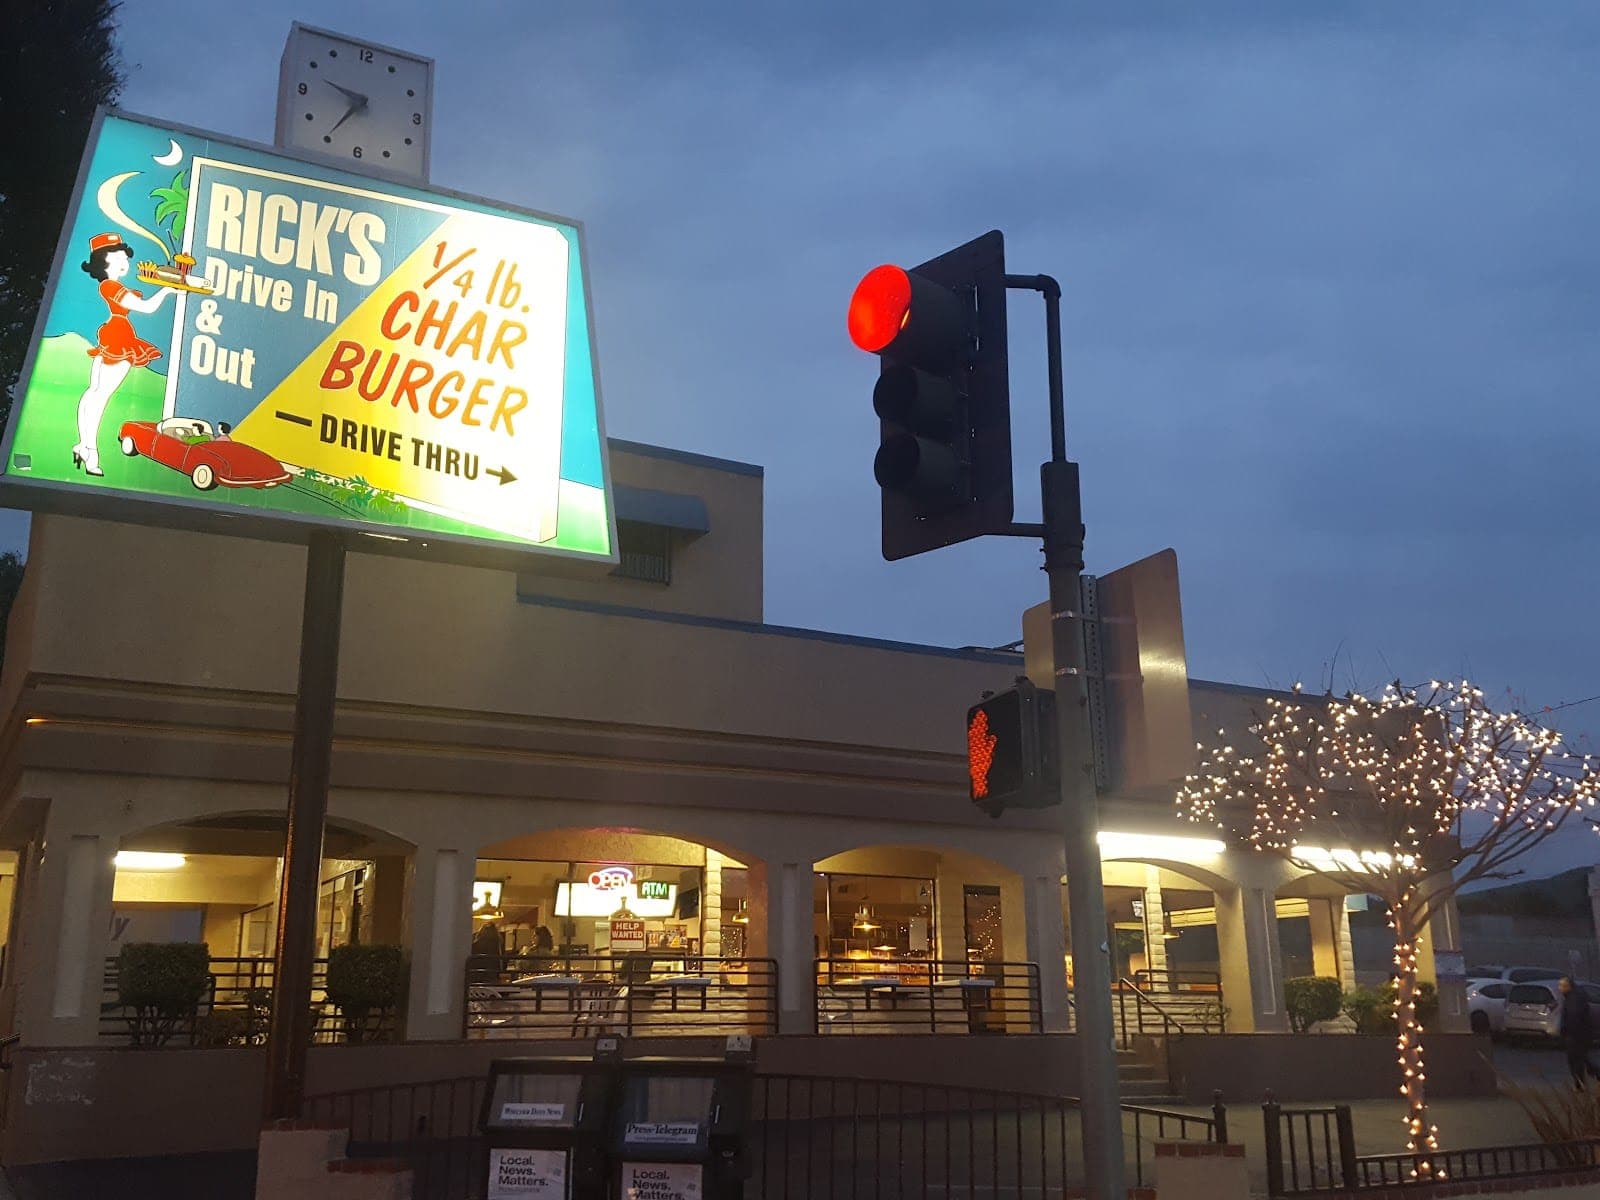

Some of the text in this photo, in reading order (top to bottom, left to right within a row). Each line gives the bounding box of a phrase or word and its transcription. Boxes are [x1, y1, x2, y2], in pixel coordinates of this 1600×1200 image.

[359, 49, 374, 64] 12
[297, 82, 308, 96] 9
[412, 113, 422, 126] 3
[353, 146, 363, 159] 6
[206, 182, 386, 287] RICK'S
[204, 256, 339, 324] Drive In
[485, 259, 530, 313] lb.
[195, 299, 225, 335] &
[381, 290, 528, 369] CHAR
[189, 335, 256, 389] Out
[319, 340, 529, 437] BURGER
[320, 413, 479, 481] DRIVE THRU
[588, 871, 632, 890] OPEN
[641, 882, 668, 897] ATM
[615, 922, 640, 931] HELP
[611, 930, 644, 939] WANTED
[500, 1155, 535, 1166] Local.
[500, 1166, 536, 1176] News.
[633, 1168, 670, 1179] Local.
[498, 1176, 549, 1187] Matters.
[632, 1179, 671, 1190] News.
